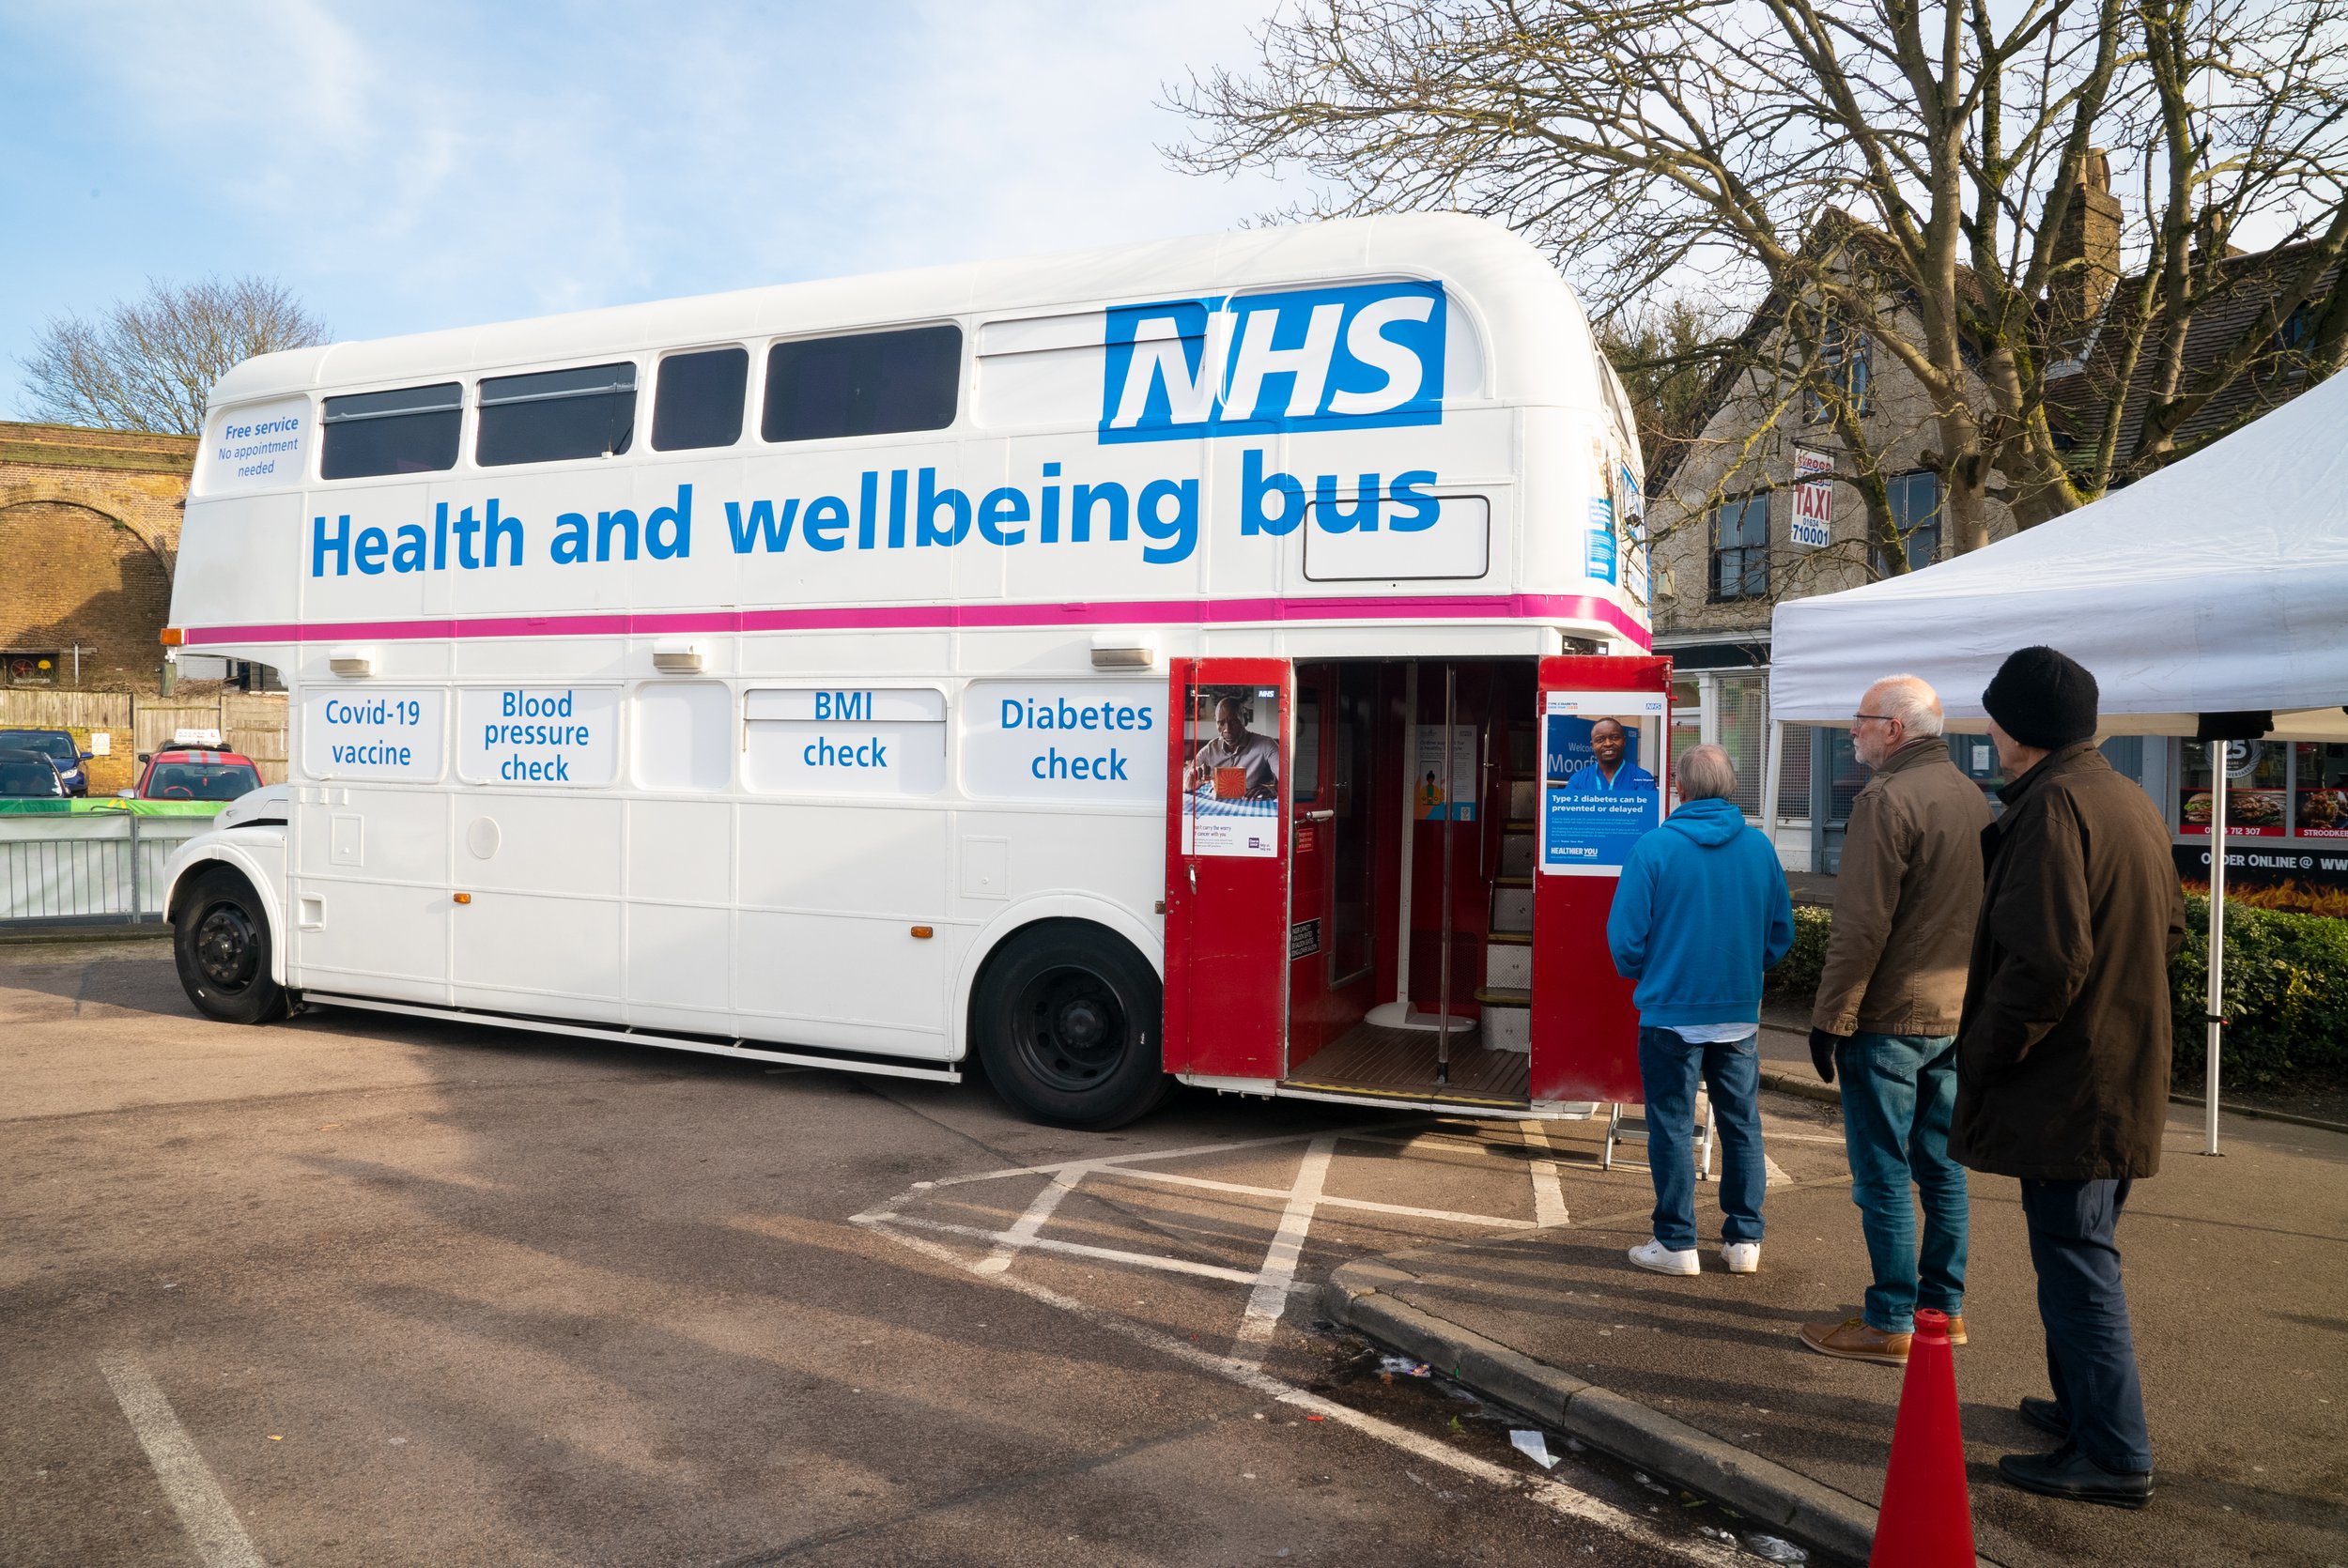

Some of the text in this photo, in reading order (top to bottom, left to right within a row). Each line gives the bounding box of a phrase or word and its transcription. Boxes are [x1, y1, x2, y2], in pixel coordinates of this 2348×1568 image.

[1109, 296, 1437, 428] NHS
[225, 416, 299, 439] Free service
[218, 438, 299, 460] No appointment
[238, 460, 275, 477] needed
[312, 449, 1442, 577] Health and wellbeing bus
[1794, 484, 1831, 521] TAXI
[1793, 524, 1829, 546] 710001
[1803, 517, 1819, 528] 01634
[326, 699, 421, 726] Covid-19
[502, 690, 573, 717] Blood
[814, 691, 873, 720] BMI
[1001, 698, 1153, 730] Diabetes
[485, 722, 590, 750] pressure
[332, 740, 411, 766] vaccine
[803, 736, 888, 767] check
[1031, 747, 1128, 780] check
[501, 754, 569, 781] check
[1552, 795, 1571, 804] Type
[1609, 806, 1644, 814] delayed
[2201, 853, 2246, 867] ODER
[2248, 854, 2297, 869] ONLINE
[2299, 856, 2313, 869] @
